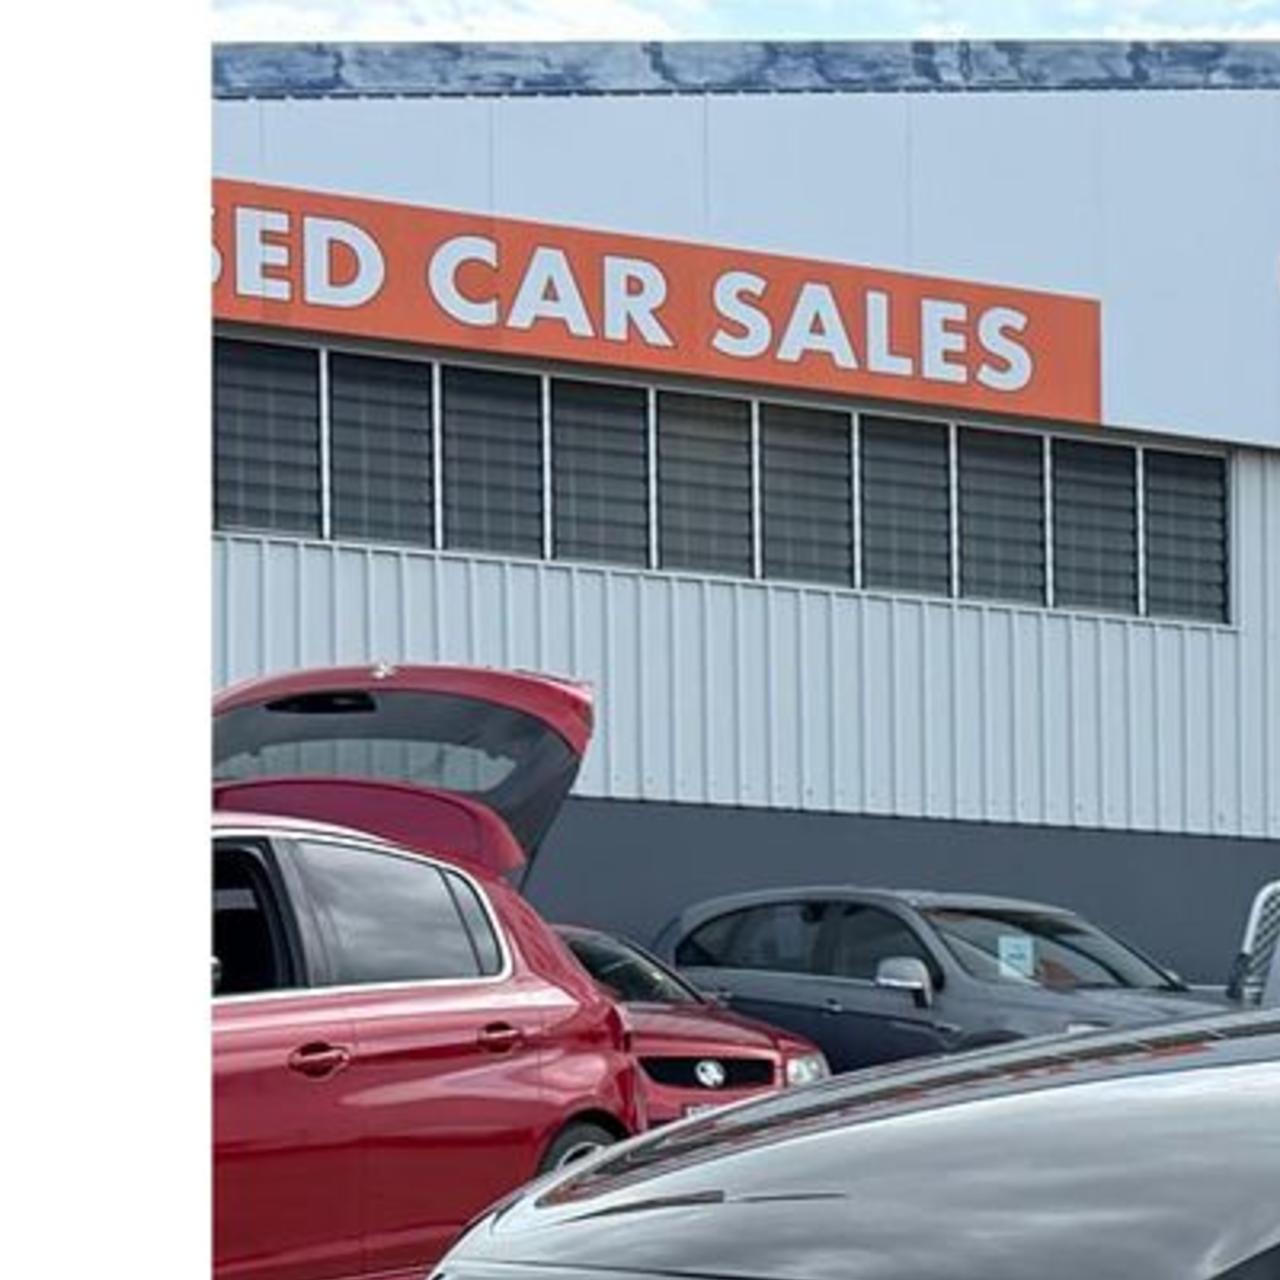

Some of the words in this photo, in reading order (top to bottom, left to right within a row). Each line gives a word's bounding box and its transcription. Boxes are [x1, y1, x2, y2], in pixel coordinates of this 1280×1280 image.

[212, 204, 386, 308] ED
[427, 234, 675, 348] CAR
[711, 271, 1036, 392] SALES
